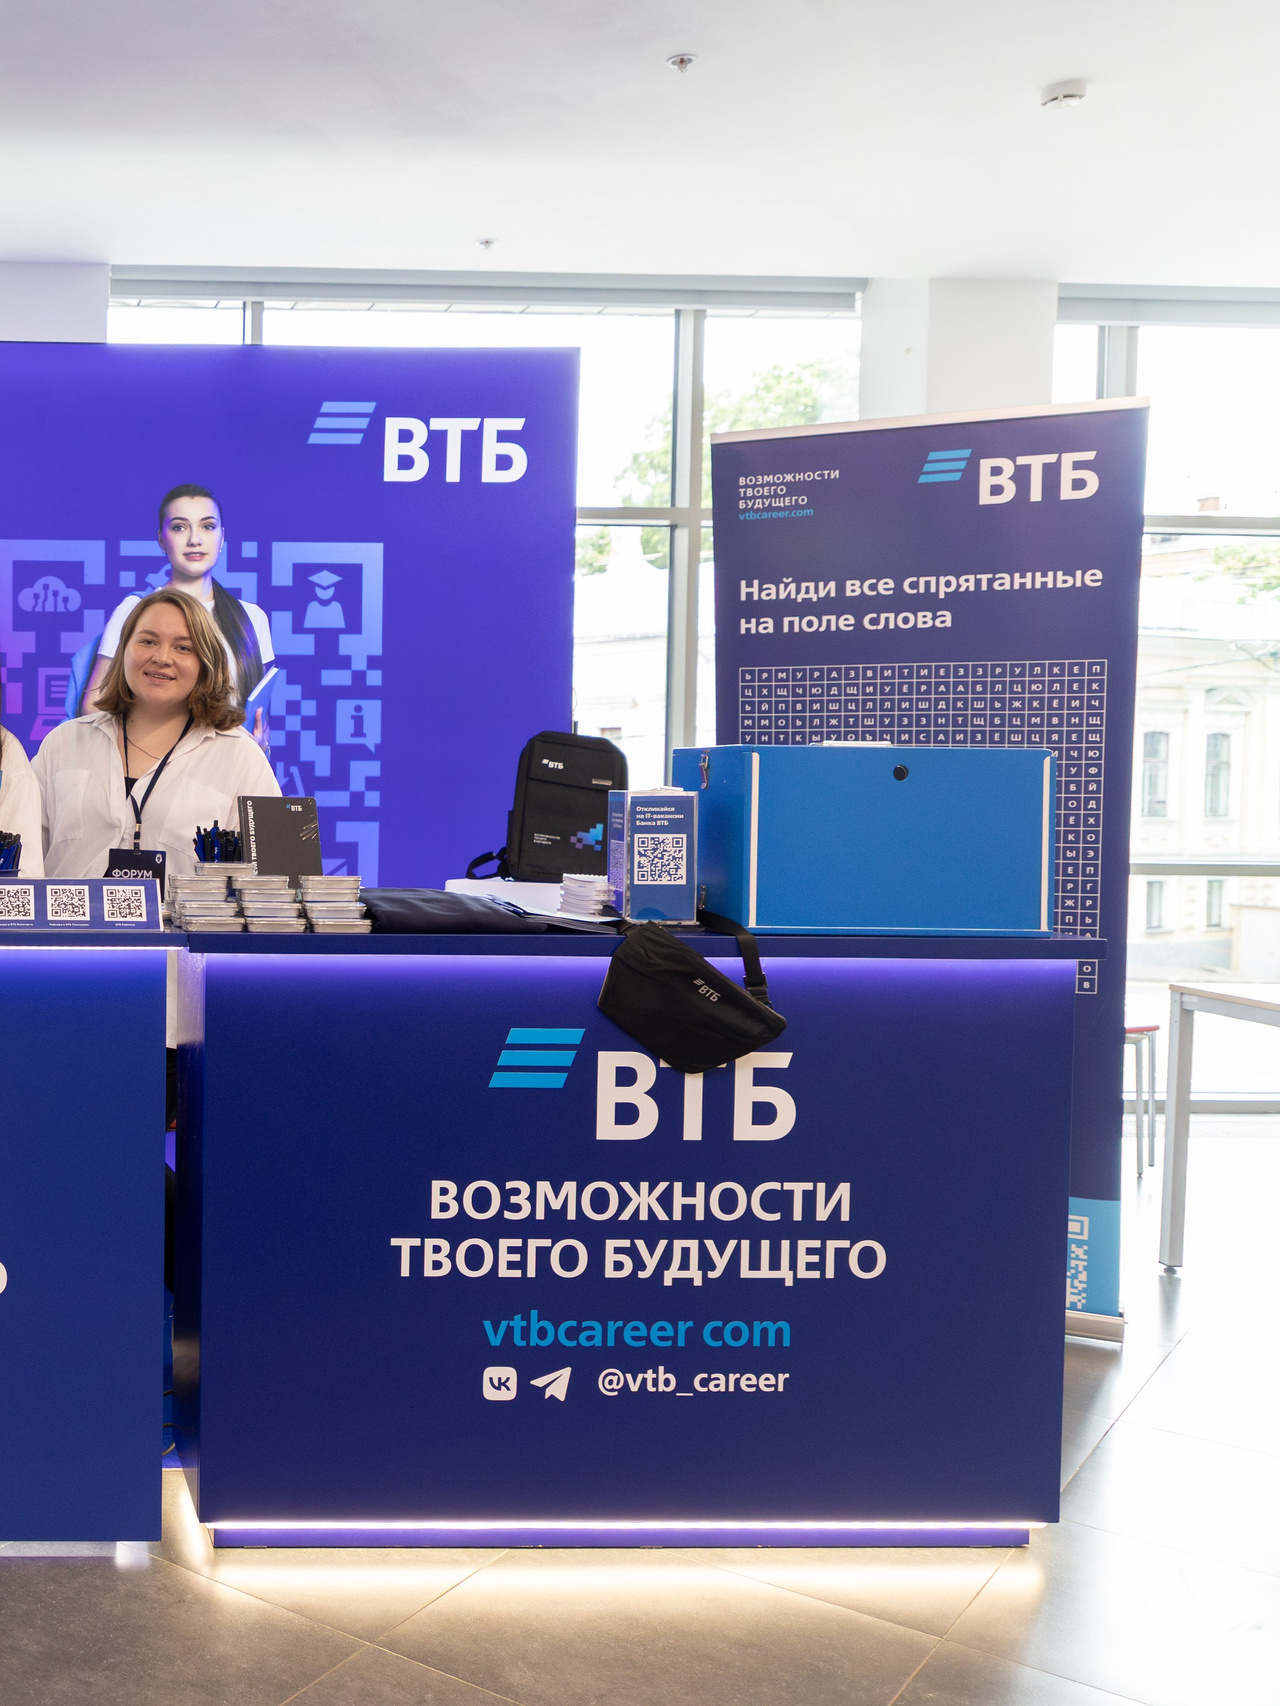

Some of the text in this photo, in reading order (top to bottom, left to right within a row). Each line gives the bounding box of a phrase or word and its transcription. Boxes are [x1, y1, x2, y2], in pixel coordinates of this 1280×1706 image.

[384, 417, 528, 483] ВТБ
[739, 470, 840, 486] ВОЗМОЖНОСТИ
[979, 451, 1100, 505] ВТБ
[739, 485, 786, 497] ТВОЕГО
[739, 496, 808, 509] БУДУЩЕГО
[739, 508, 814, 521] vtbcareer.com
[740, 568, 1103, 602] Найди все спрятанные
[740, 610, 952, 634] на поле слова
[548, 761, 564, 770] ВТБ
[246, 800, 256, 835] БУДУЩЕГО
[249, 836, 257, 861] ТВОЕГО
[112, 868, 153, 878] ФОРУМ
[698, 985, 721, 1002] ВТБ
[595, 1050, 797, 1141] ВТБ
[430, 1180, 851, 1222] ВОЗМОЖНОСТИ
[390, 1238, 887, 1287] ТВОЕГО БУДУЩЕГО
[598, 1365, 790, 1397] @vtb_career
